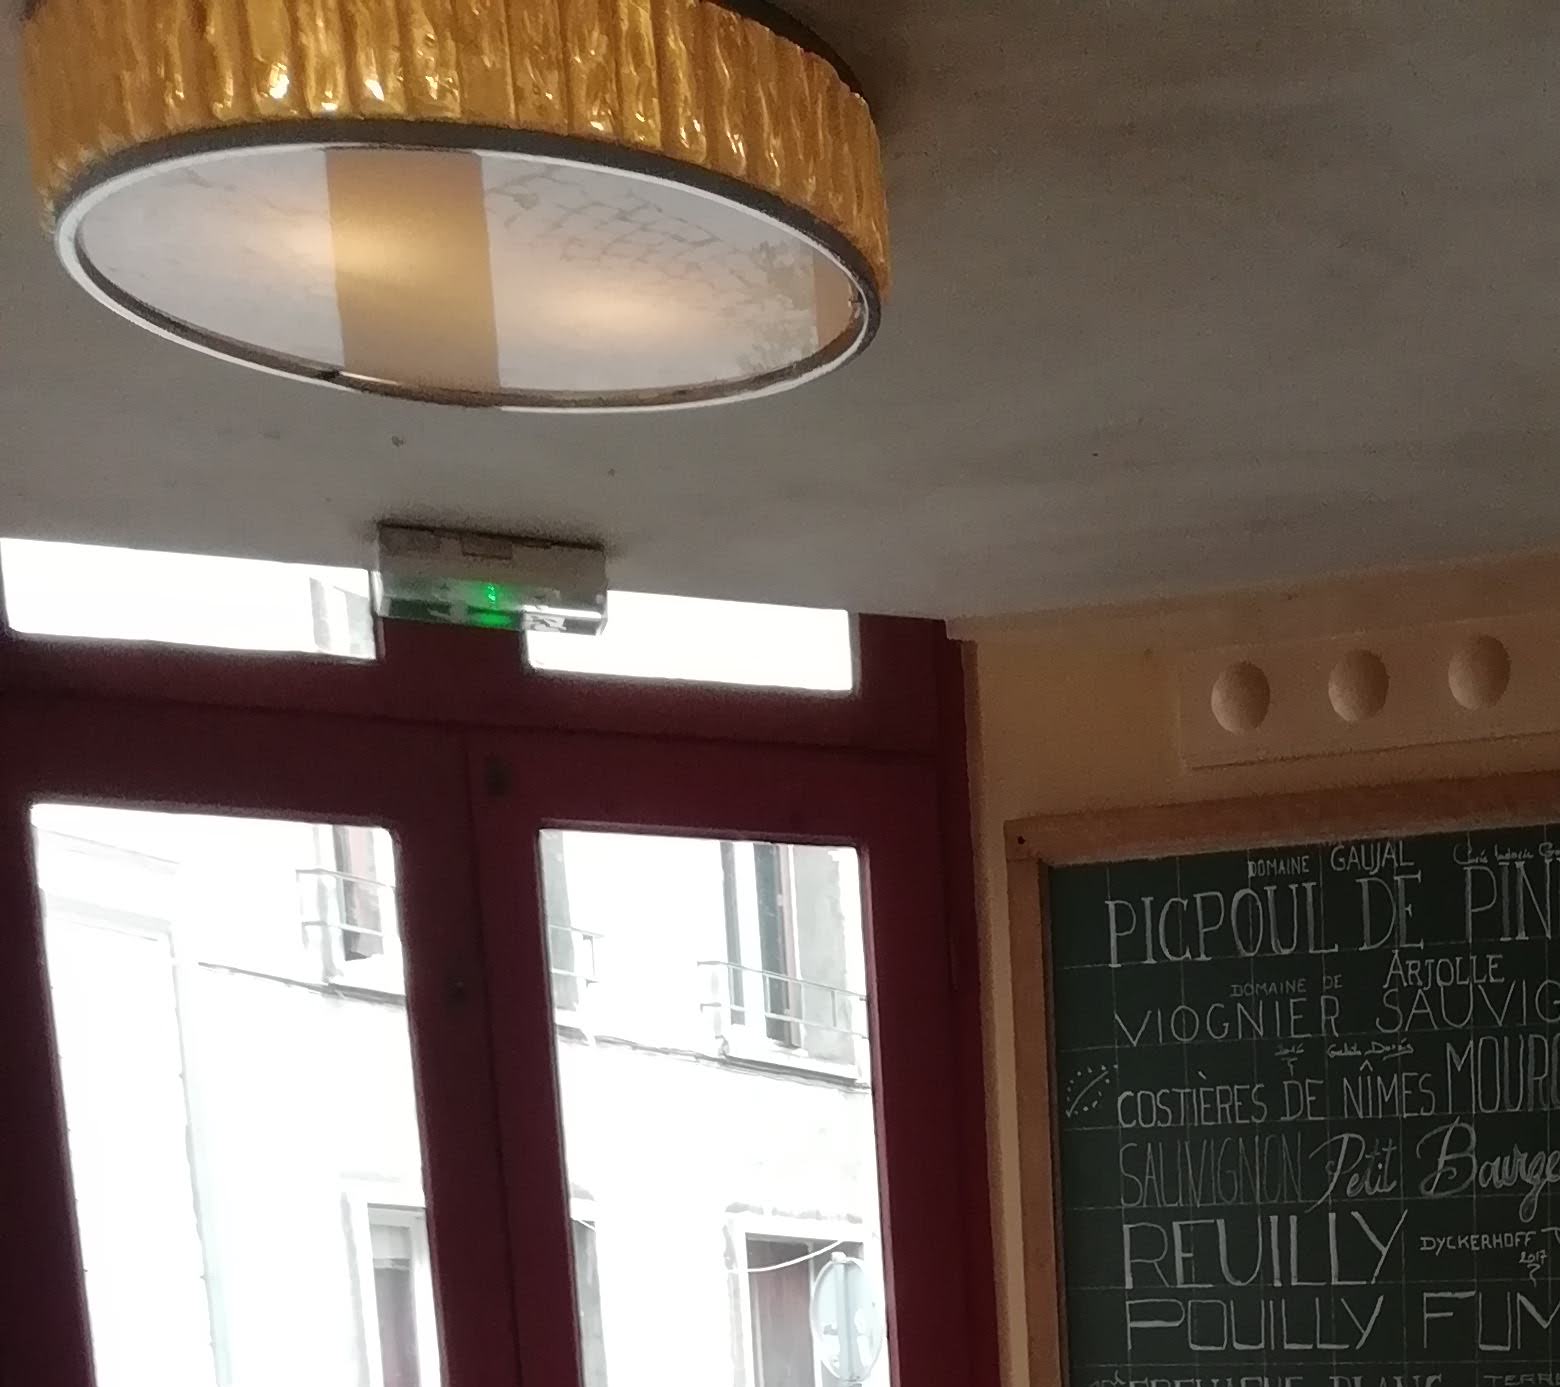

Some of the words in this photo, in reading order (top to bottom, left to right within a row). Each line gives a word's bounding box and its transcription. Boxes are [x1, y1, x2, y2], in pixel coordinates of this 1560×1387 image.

[1248, 855, 1310, 879] DOMAINE
[1330, 840, 1415, 874] GAUJAL
[1104, 881, 1339, 968] PICPOUL
[1355, 870, 1424, 952] DE
[1230, 977, 1307, 999] DOMAINE
[1322, 974, 1343, 991] DE
[1383, 950, 1505, 989] ARJOLLE
[1114, 995, 1340, 1046] VIOGNIER
[1117, 1069, 1267, 1128] COSTIÈRES
[1280, 1079, 1327, 1121] DE
[1342, 1058, 1436, 1119] NÎMES
[1119, 1132, 1302, 1208] SAUVIGNON
[1307, 1132, 1398, 1215] Petit
[1122, 1208, 1408, 1290] REUILLY
[1418, 1230, 1537, 1256] DYCKERHOFF
[1125, 1295, 1384, 1352] POUILLY
